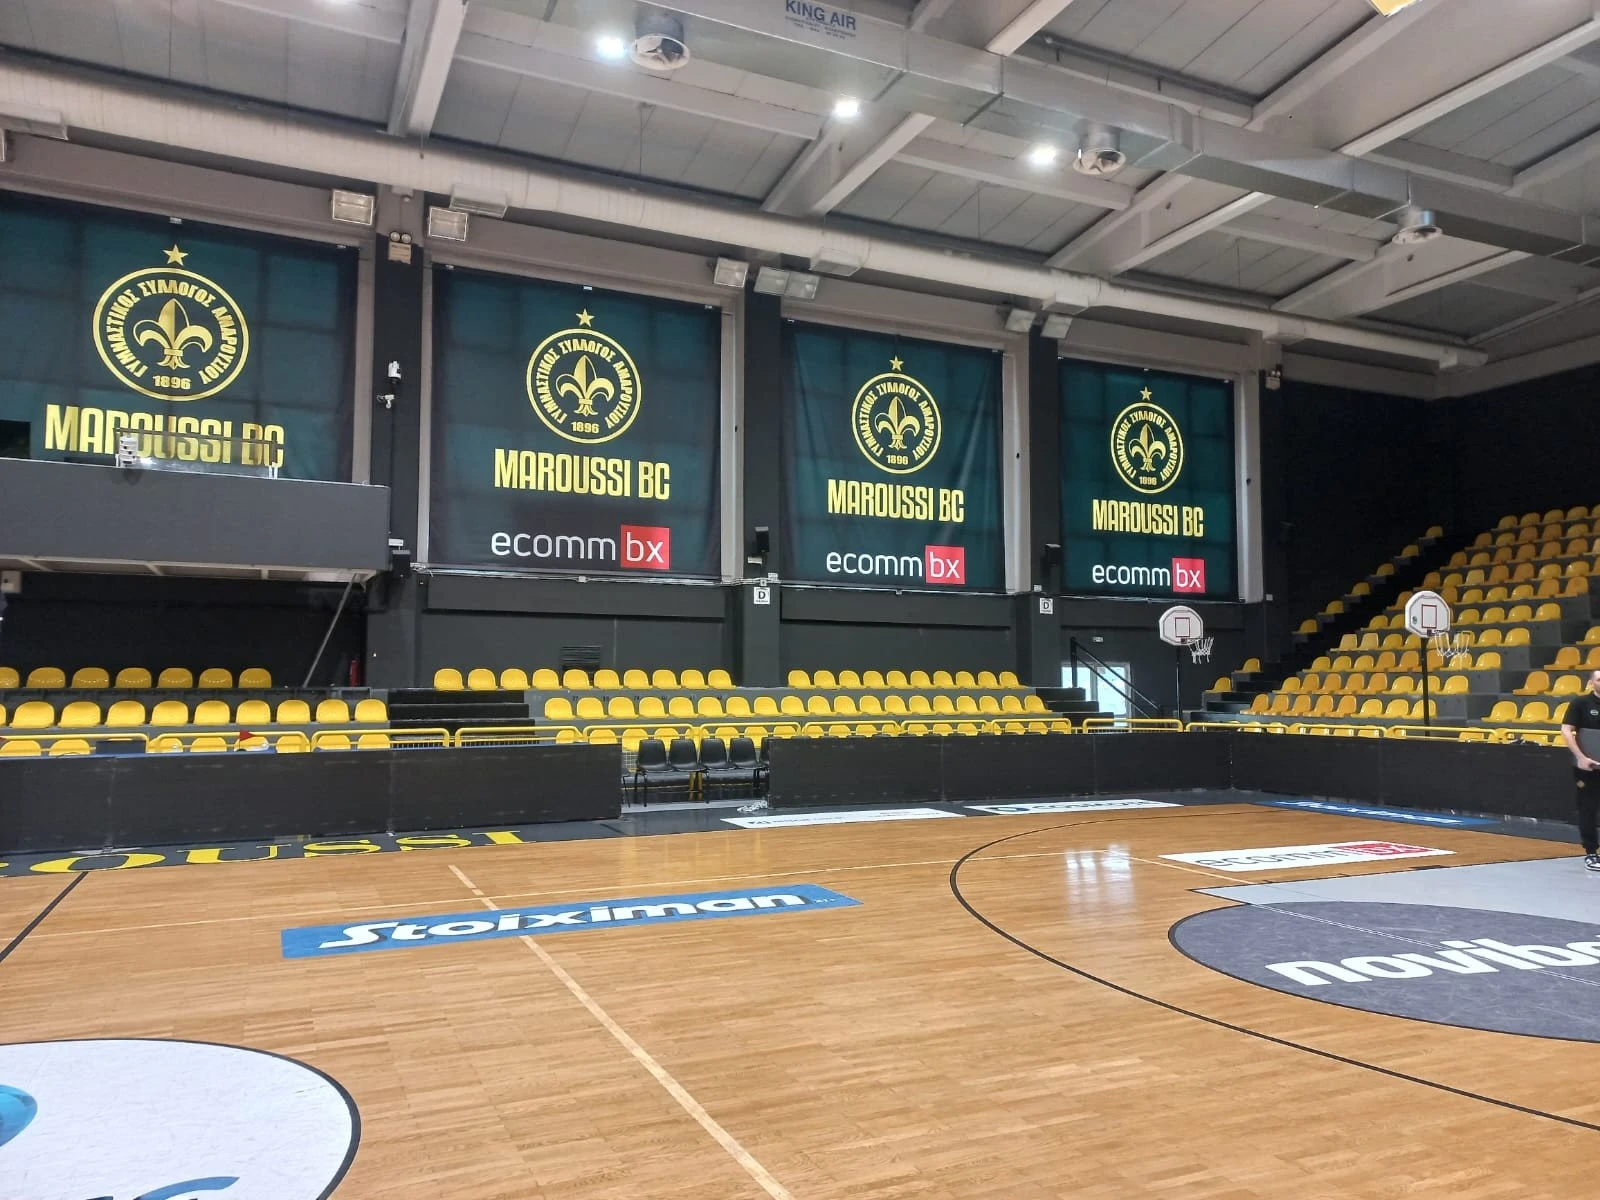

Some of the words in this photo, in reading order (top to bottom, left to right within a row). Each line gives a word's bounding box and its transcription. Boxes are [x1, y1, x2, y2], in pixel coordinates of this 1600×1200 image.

[786, 0, 825, 22] KING
[830, 11, 857, 31] AIR
[152, 374, 191, 391] 1896
[241, 422, 285, 469] BC
[570, 420, 600, 434] 1896
[494, 447, 632, 497] MAROUSSI
[638, 461, 670, 501] BC
[827, 479, 934, 521] MAROUSSI
[938, 487, 965, 523] BC
[1092, 498, 1179, 536] MAROUSSI
[1182, 505, 1204, 538] BC
[758, 590, 766, 600] D
[0, 830, 537, 877] OUSSI
[318, 893, 807, 949] Stoiximan
